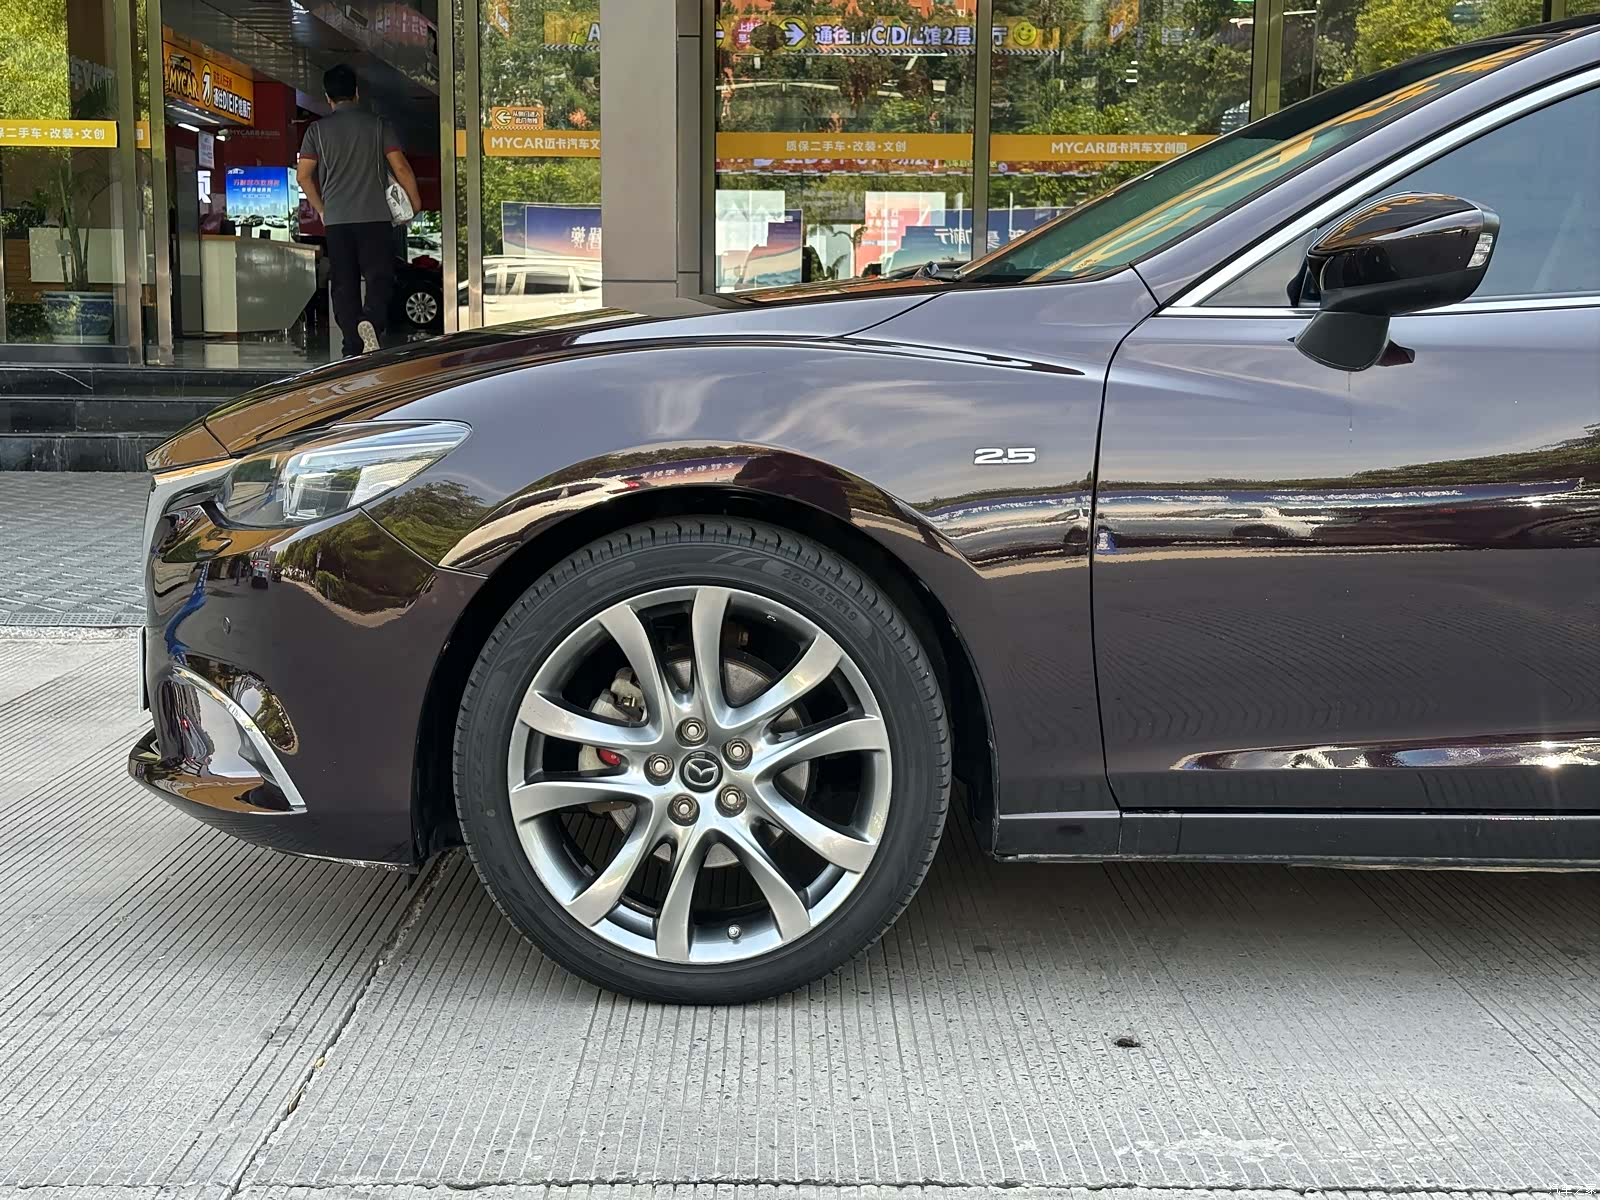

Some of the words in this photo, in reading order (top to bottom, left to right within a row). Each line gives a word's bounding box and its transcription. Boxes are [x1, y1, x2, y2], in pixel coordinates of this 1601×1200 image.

[169, 67, 199, 101] MYCAR
[974, 447, 1036, 464] 2.5
[781, 568, 858, 621] 225/45R19
